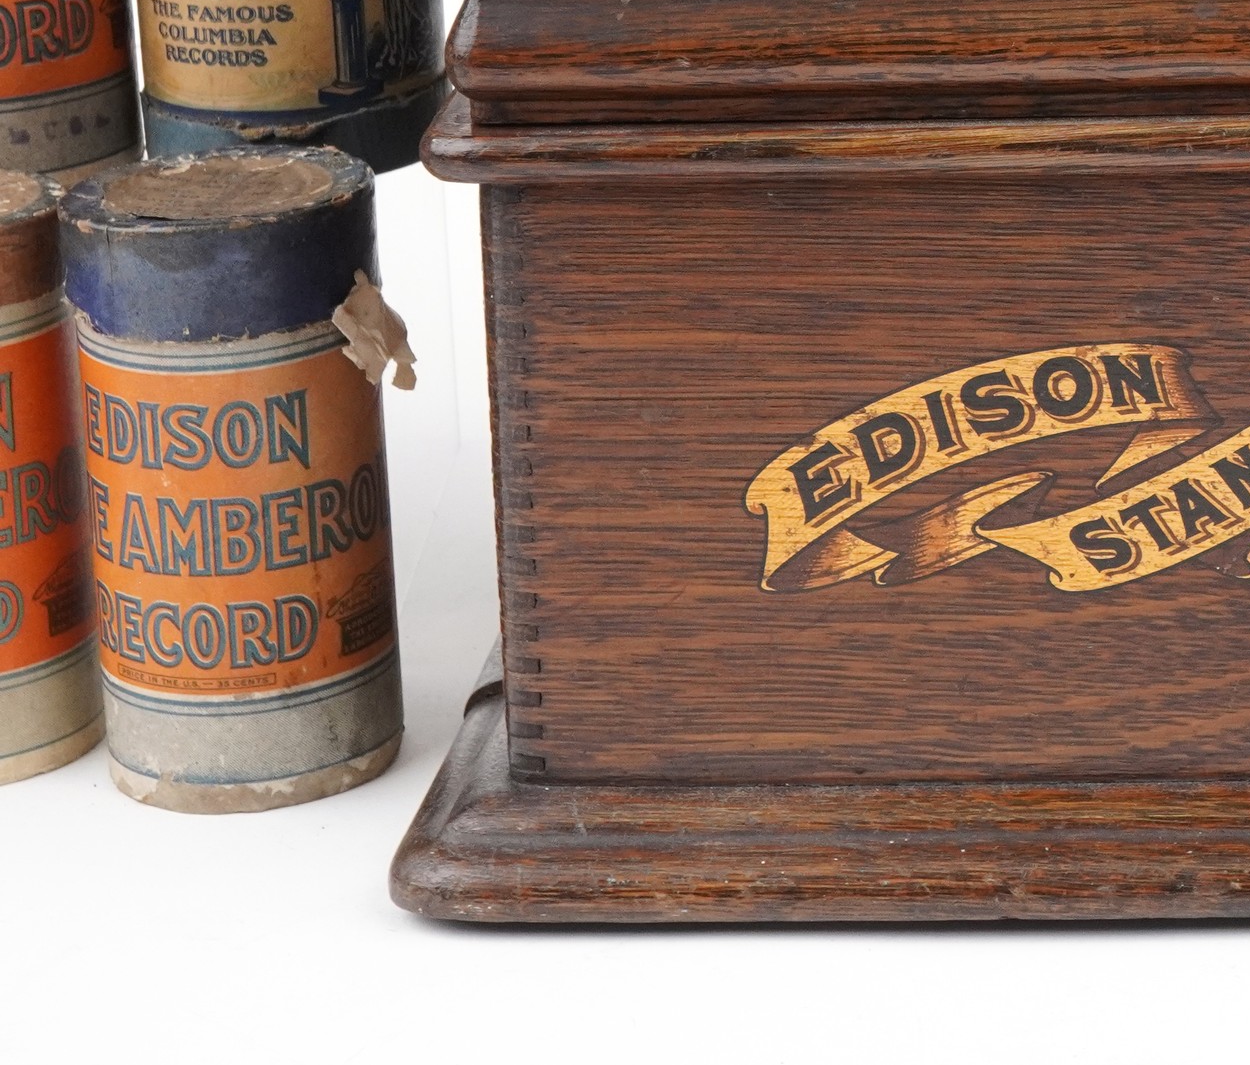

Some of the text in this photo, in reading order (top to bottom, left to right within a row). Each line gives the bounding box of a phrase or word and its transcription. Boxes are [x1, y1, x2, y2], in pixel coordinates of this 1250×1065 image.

[187, 3, 294, 24] FAMOUS
[158, 21, 278, 47] COLUMBIA
[165, 43, 269, 68] RECORDS
[85, 383, 311, 470] EDISON
[786, 353, 1174, 526] EDISON
[97, 578, 319, 670] RECORD
[162, 678, 178, 687] THE
